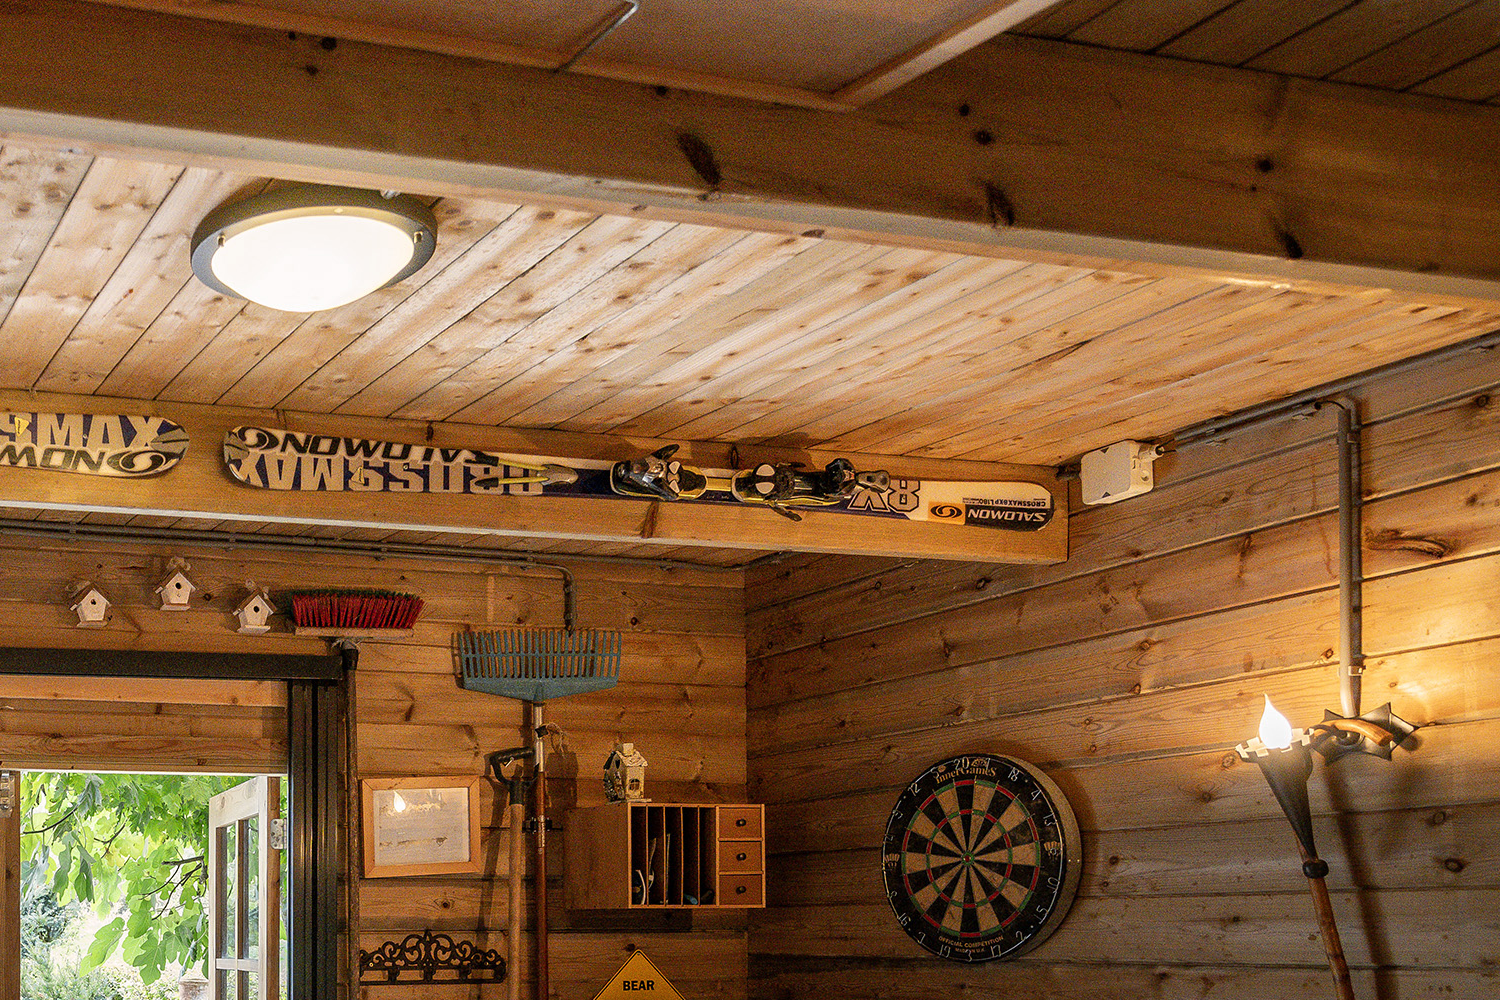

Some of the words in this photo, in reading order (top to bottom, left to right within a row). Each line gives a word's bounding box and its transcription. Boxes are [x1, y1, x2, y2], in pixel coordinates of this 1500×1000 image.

[968, 508, 1046, 522] SALOMON
[953, 756, 970, 770] 20
[1007, 766, 1020, 782] 18
[622, 980, 655, 991] BEAR
